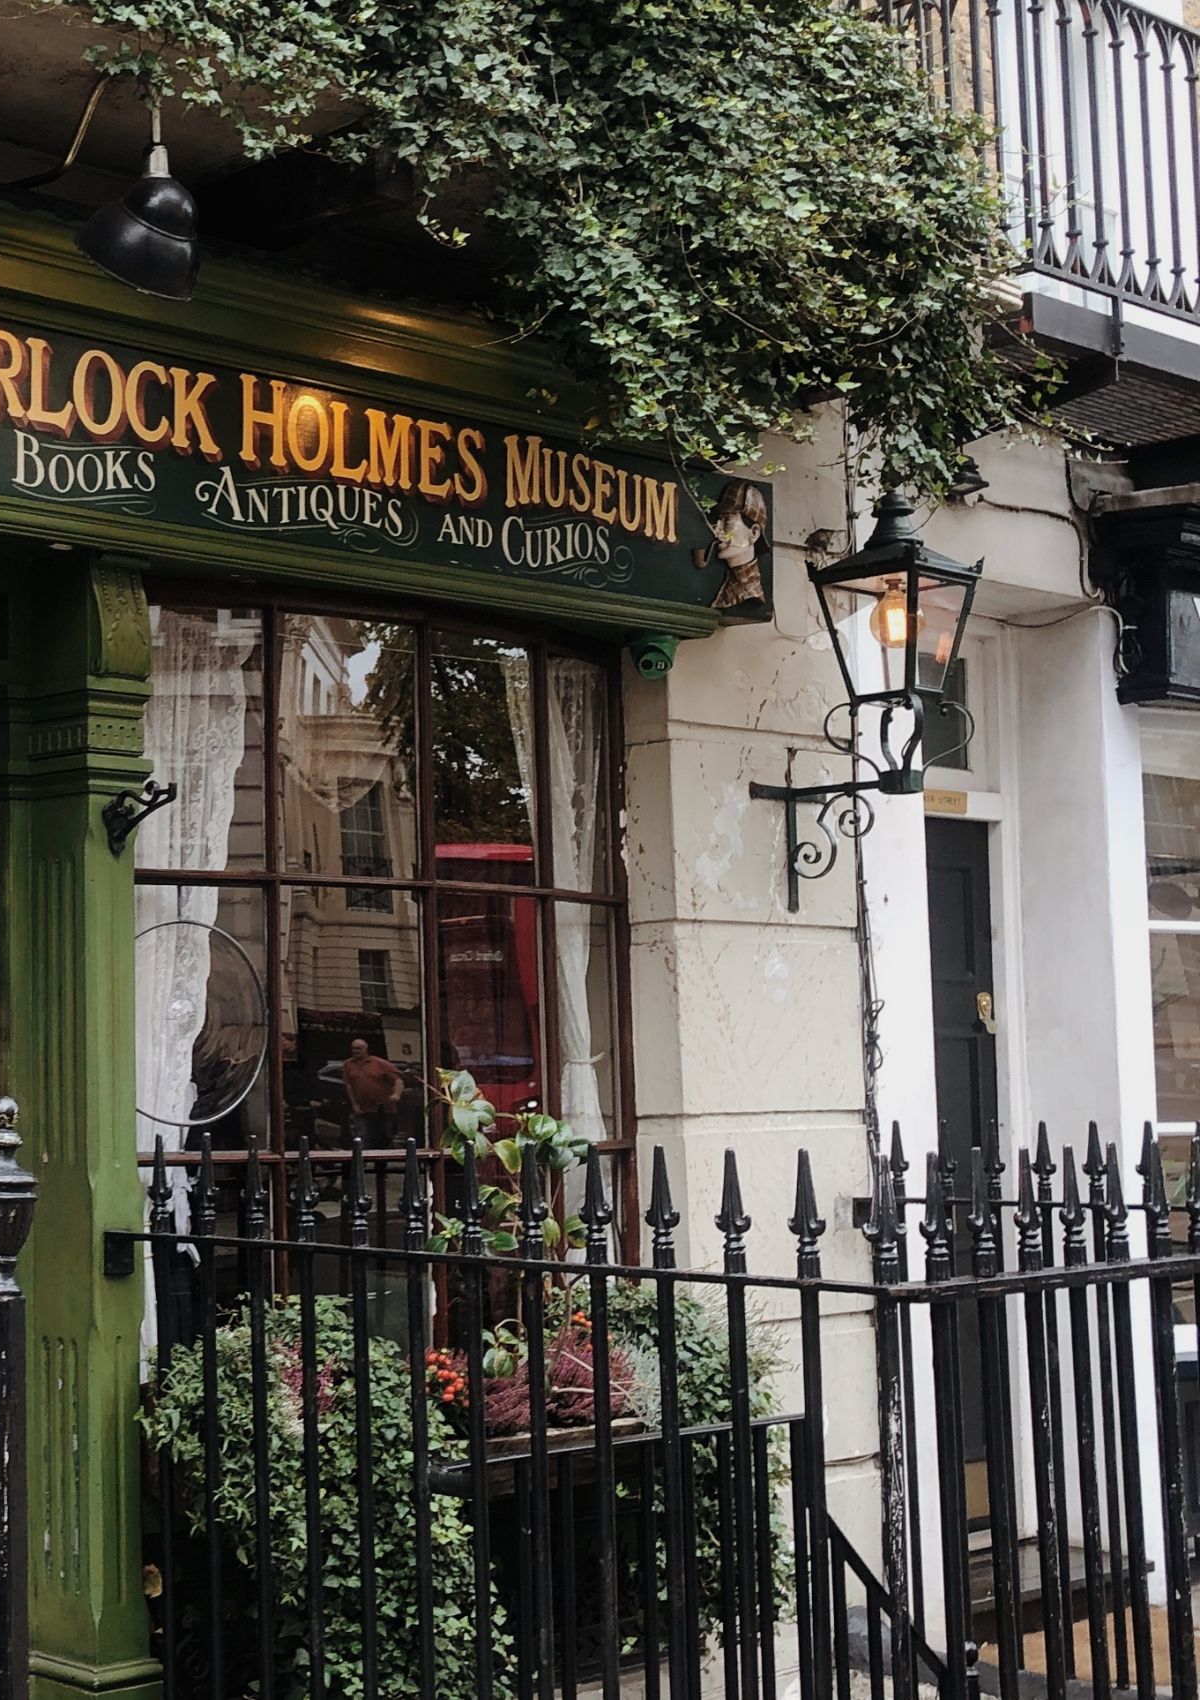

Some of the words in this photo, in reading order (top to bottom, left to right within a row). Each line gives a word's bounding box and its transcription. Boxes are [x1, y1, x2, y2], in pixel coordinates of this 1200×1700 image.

[11, 429, 156, 493] BOOKS
[195, 466, 402, 537] ANTIQUES
[437, 513, 493, 548] AND
[502, 516, 610, 568] CURIOS
[238, 373, 486, 503] HOLMES
[503, 434, 678, 544] MUSEUM
